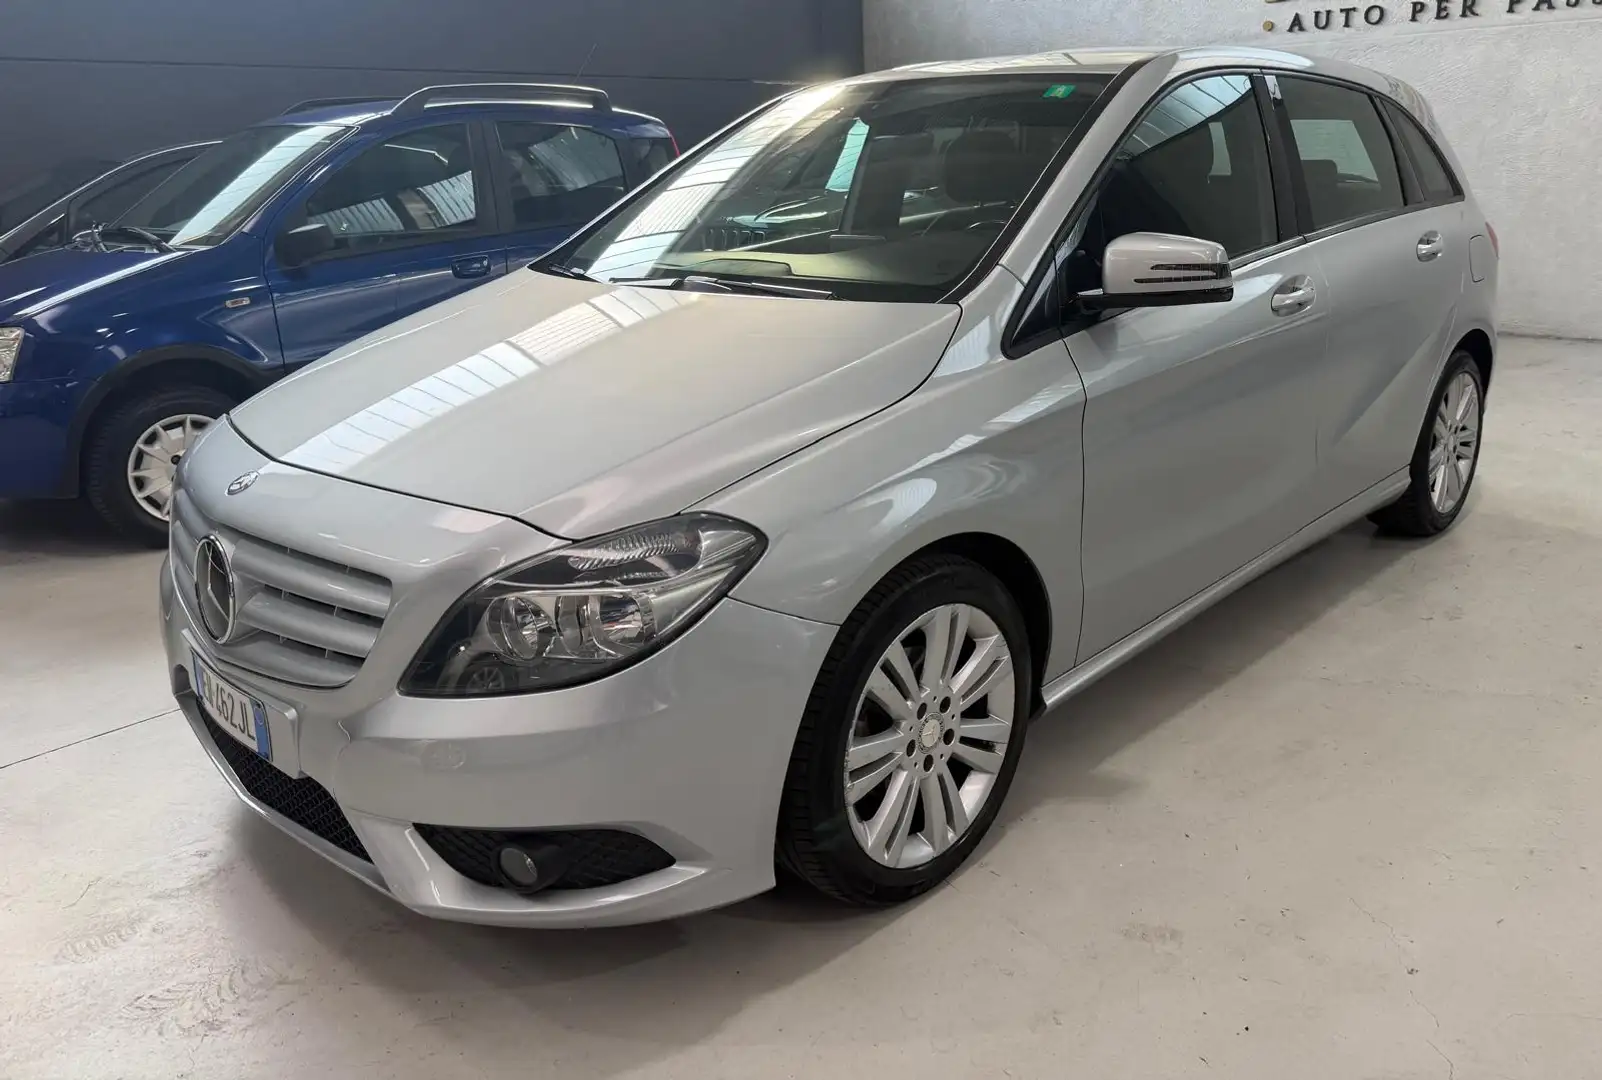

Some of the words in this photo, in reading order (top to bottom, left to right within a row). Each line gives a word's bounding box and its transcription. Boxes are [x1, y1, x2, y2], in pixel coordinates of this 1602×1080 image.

[1286, 6, 1385, 32] AUTO
[1410, 0, 1479, 22] PER
[1506, 0, 1602, 13] PA
